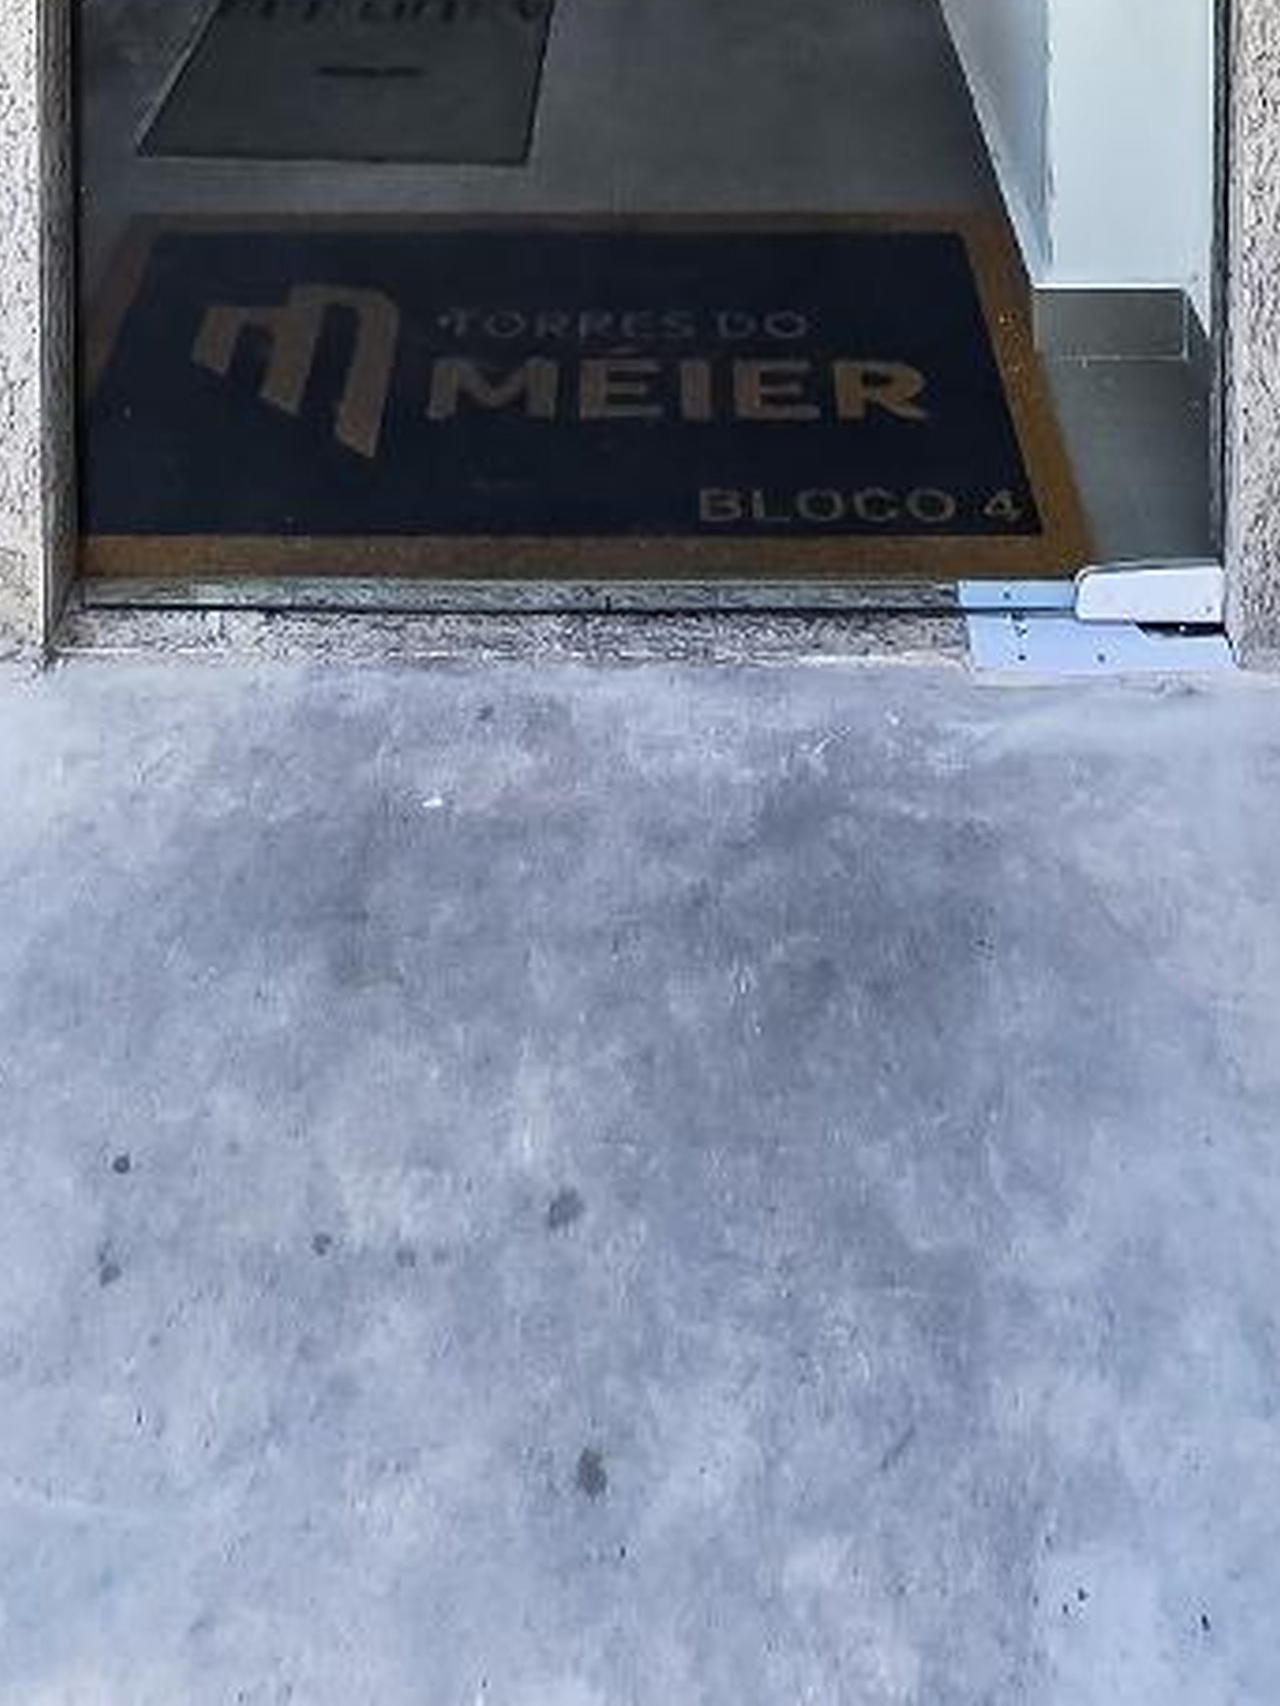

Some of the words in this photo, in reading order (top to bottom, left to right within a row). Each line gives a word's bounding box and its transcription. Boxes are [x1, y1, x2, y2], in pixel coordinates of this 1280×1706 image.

[439, 308, 697, 341] TORRES
[719, 309, 811, 340] DO
[425, 346, 930, 421] MÉIER
[700, 487, 956, 524] BLOCO
[984, 488, 1023, 524] 4
